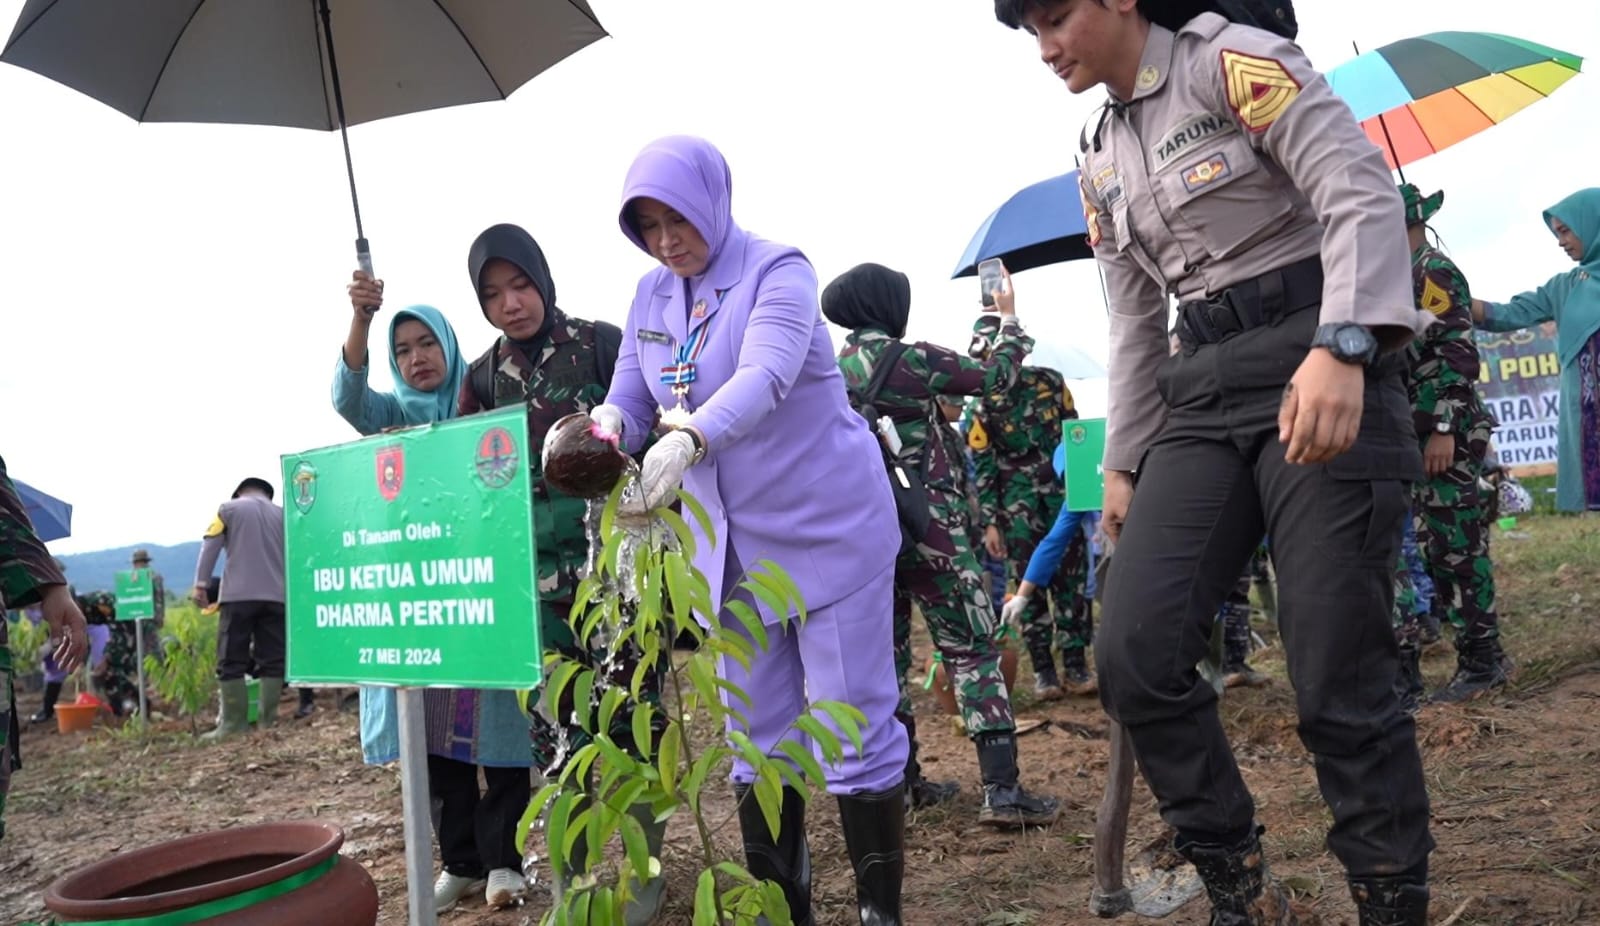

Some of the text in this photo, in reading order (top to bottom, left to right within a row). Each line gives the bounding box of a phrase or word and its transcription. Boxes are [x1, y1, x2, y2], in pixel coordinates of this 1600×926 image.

[342, 531, 356, 547] Di
[359, 528, 402, 545] Tanam
[405, 521, 442, 541] Oleh
[314, 556, 494, 592] IBU KETUA UMUM
[316, 598, 495, 628] DHARMA PERTIWI
[359, 647, 442, 665] 27 MEI 2024
